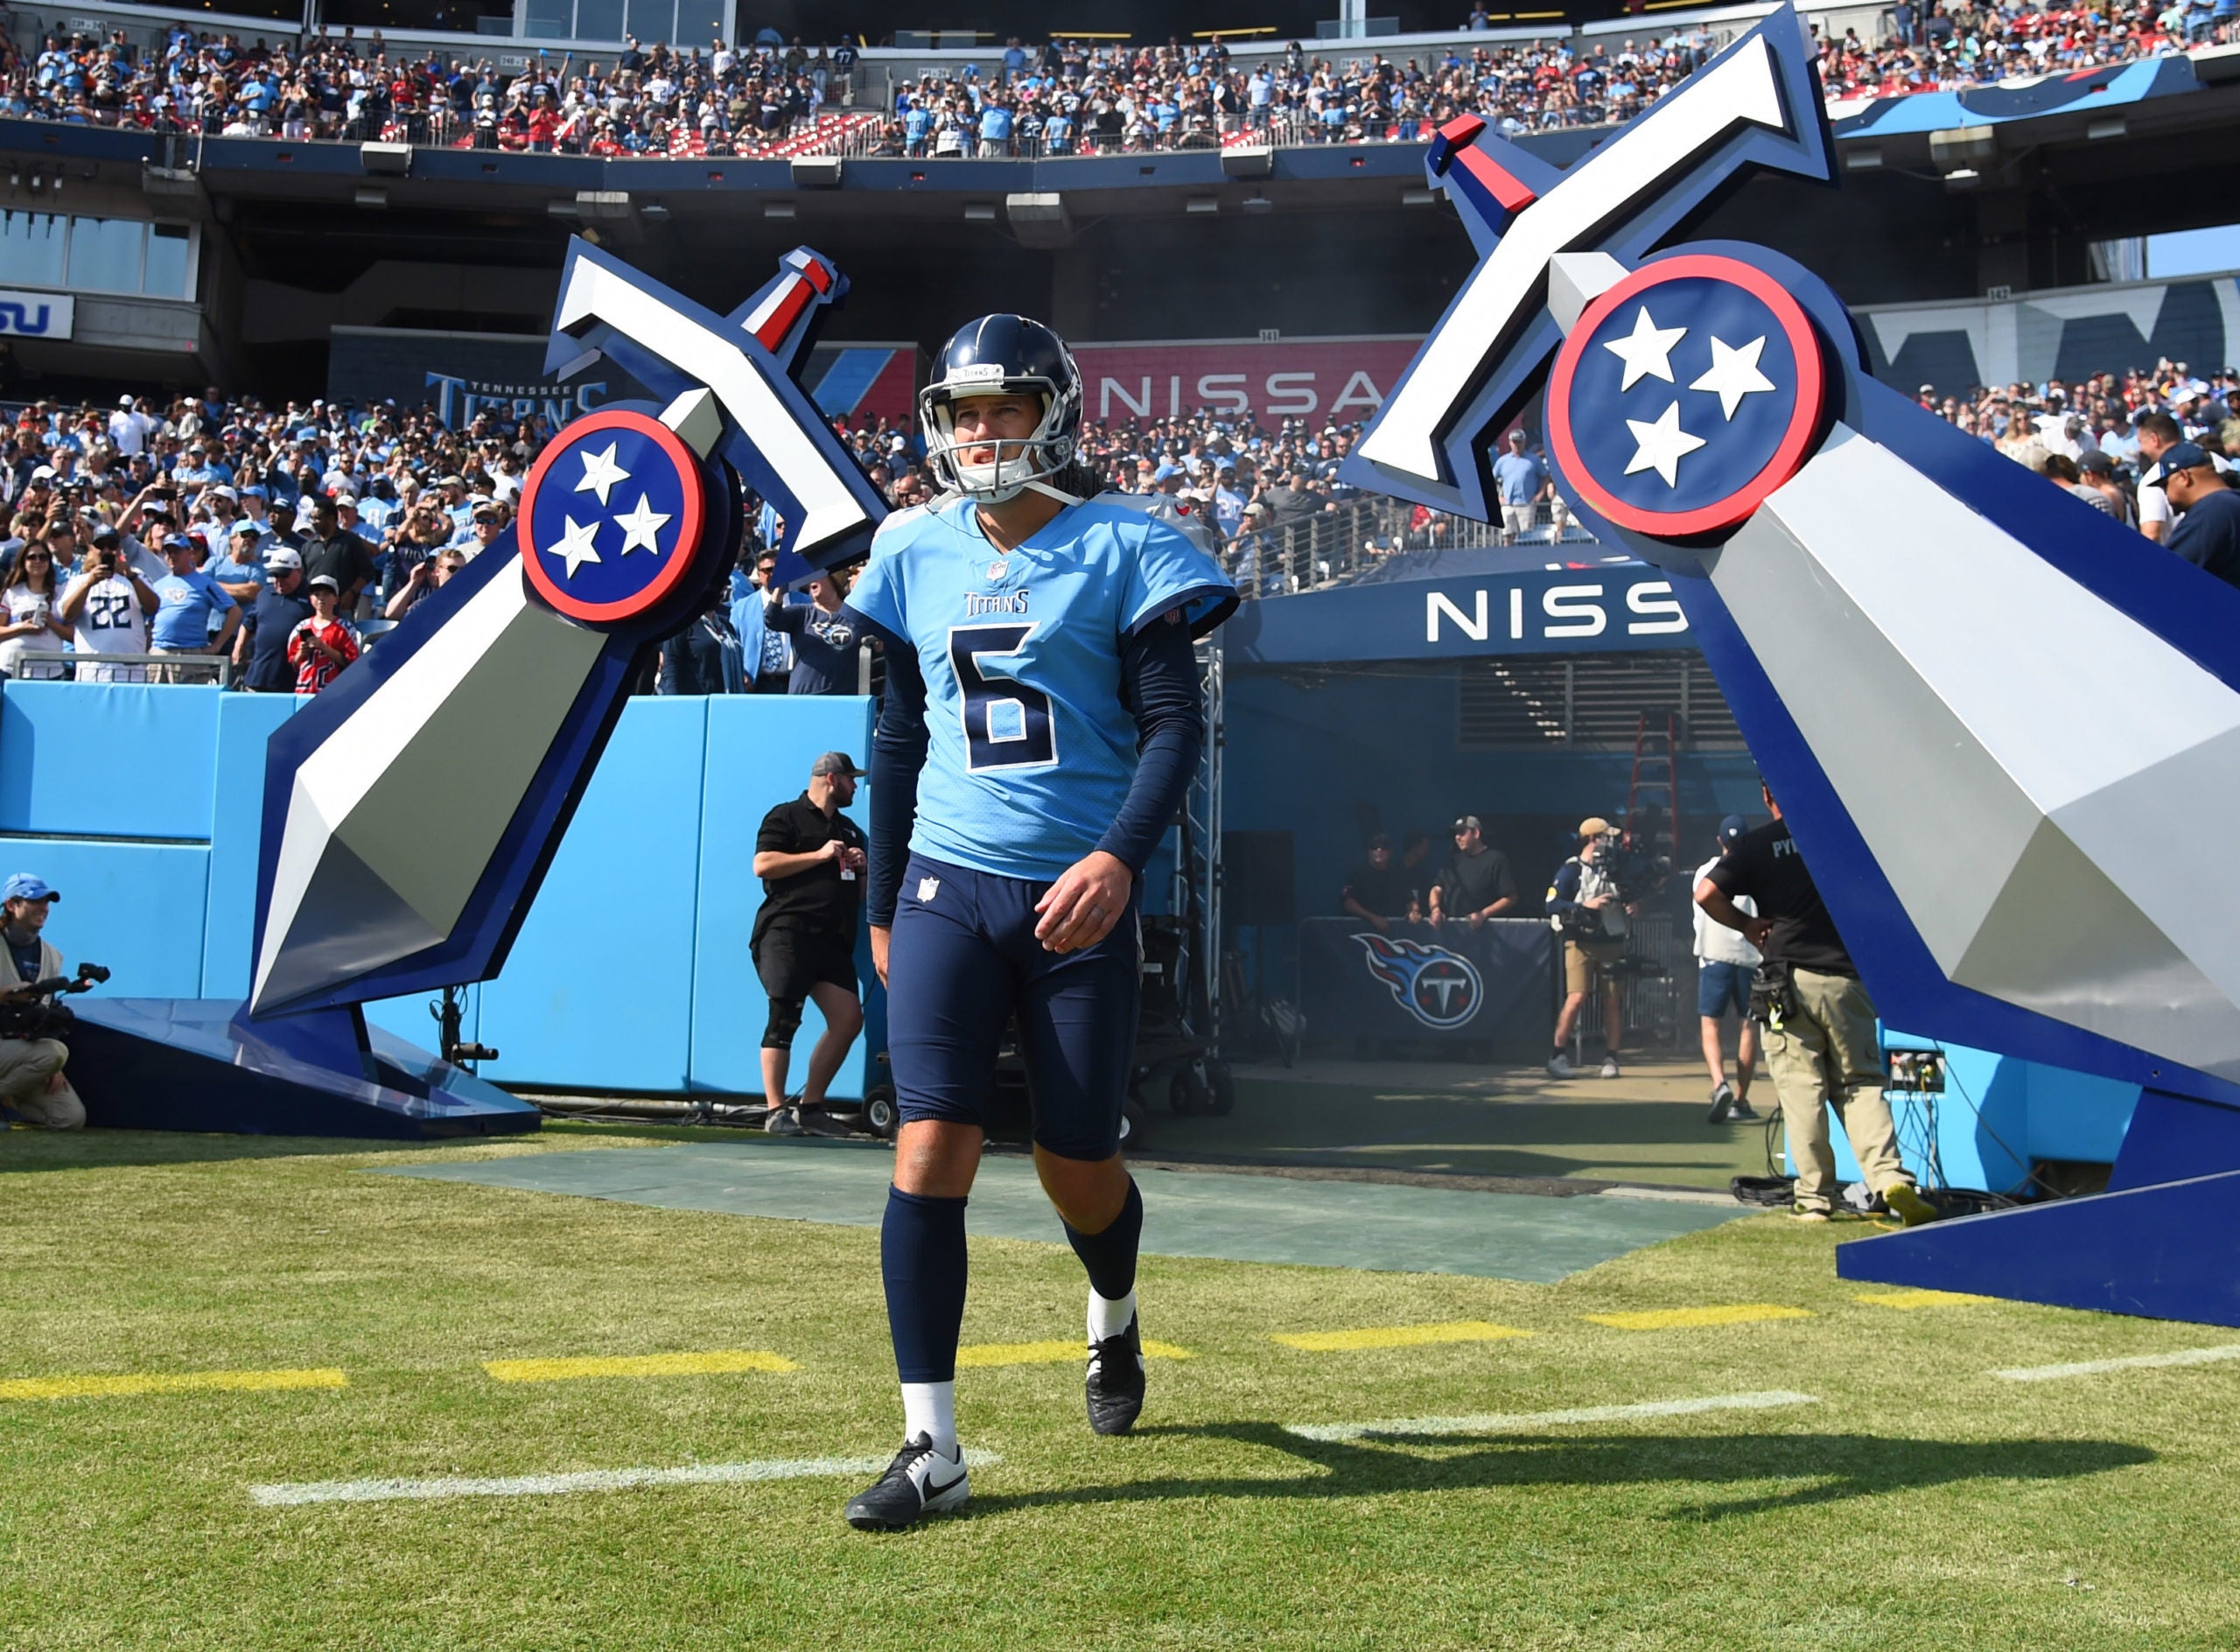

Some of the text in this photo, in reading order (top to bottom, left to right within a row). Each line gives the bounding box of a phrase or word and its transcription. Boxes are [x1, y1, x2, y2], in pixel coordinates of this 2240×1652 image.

[837, 52, 851, 64] 77
[1262, 331, 1278, 342] 141
[963, 368, 988, 377] TITANS
[471, 381, 571, 395] TENNESSEE
[963, 589, 1029, 618] TITANS
[90, 595, 132, 630] 22
[948, 620, 1060, 774] 6
